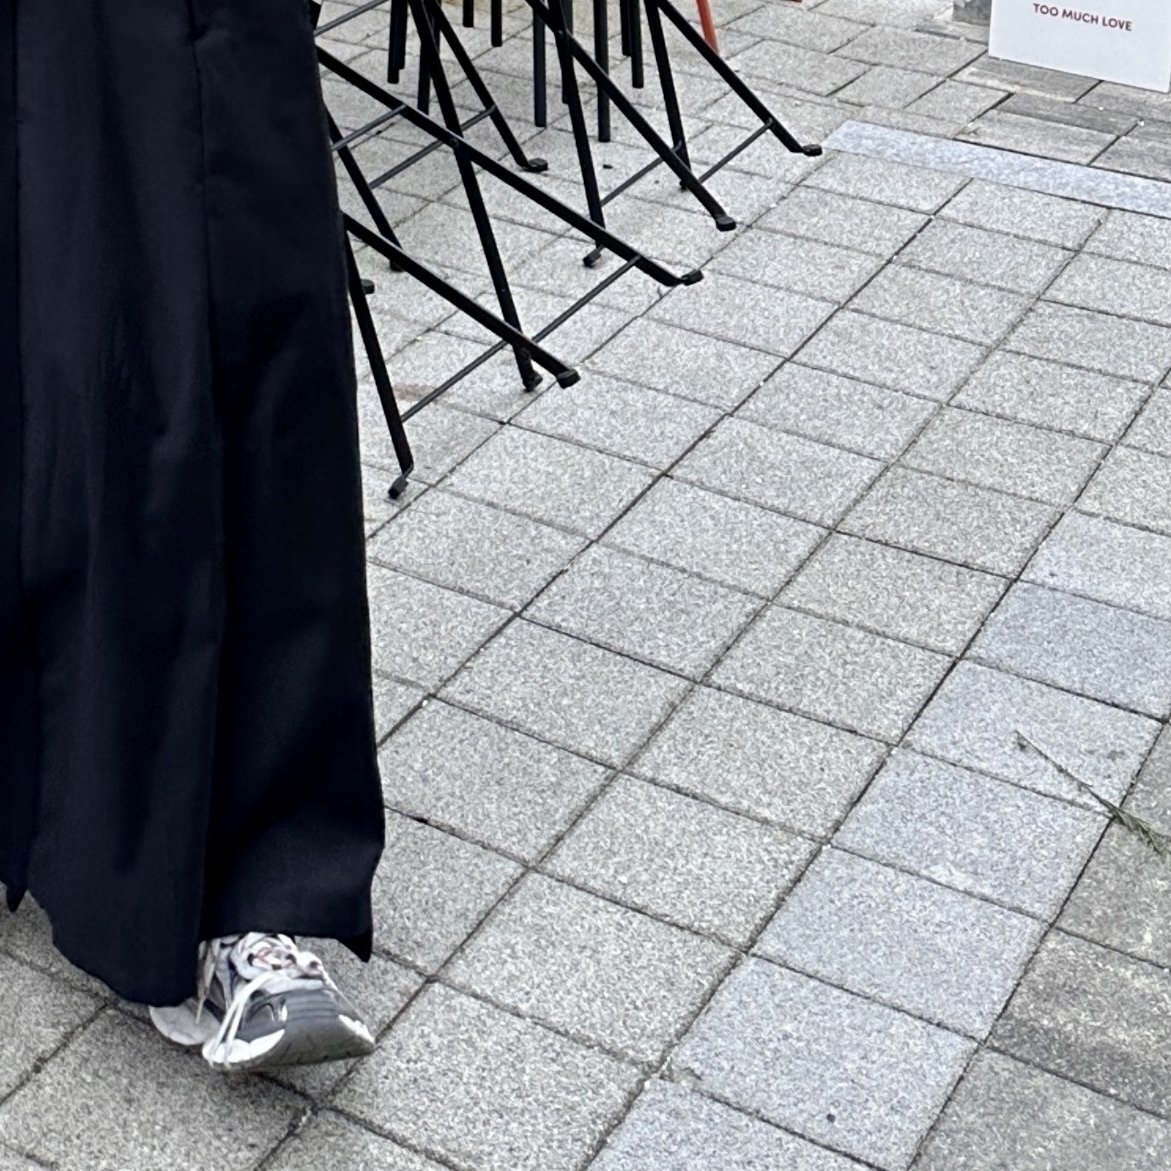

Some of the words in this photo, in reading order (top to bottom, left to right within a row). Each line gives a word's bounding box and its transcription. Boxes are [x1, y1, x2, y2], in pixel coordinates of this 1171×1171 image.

[1033, 3, 1059, 17] TOO
[1062, 8, 1099, 25] MUCH
[1103, 17, 1132, 31] LOVE
